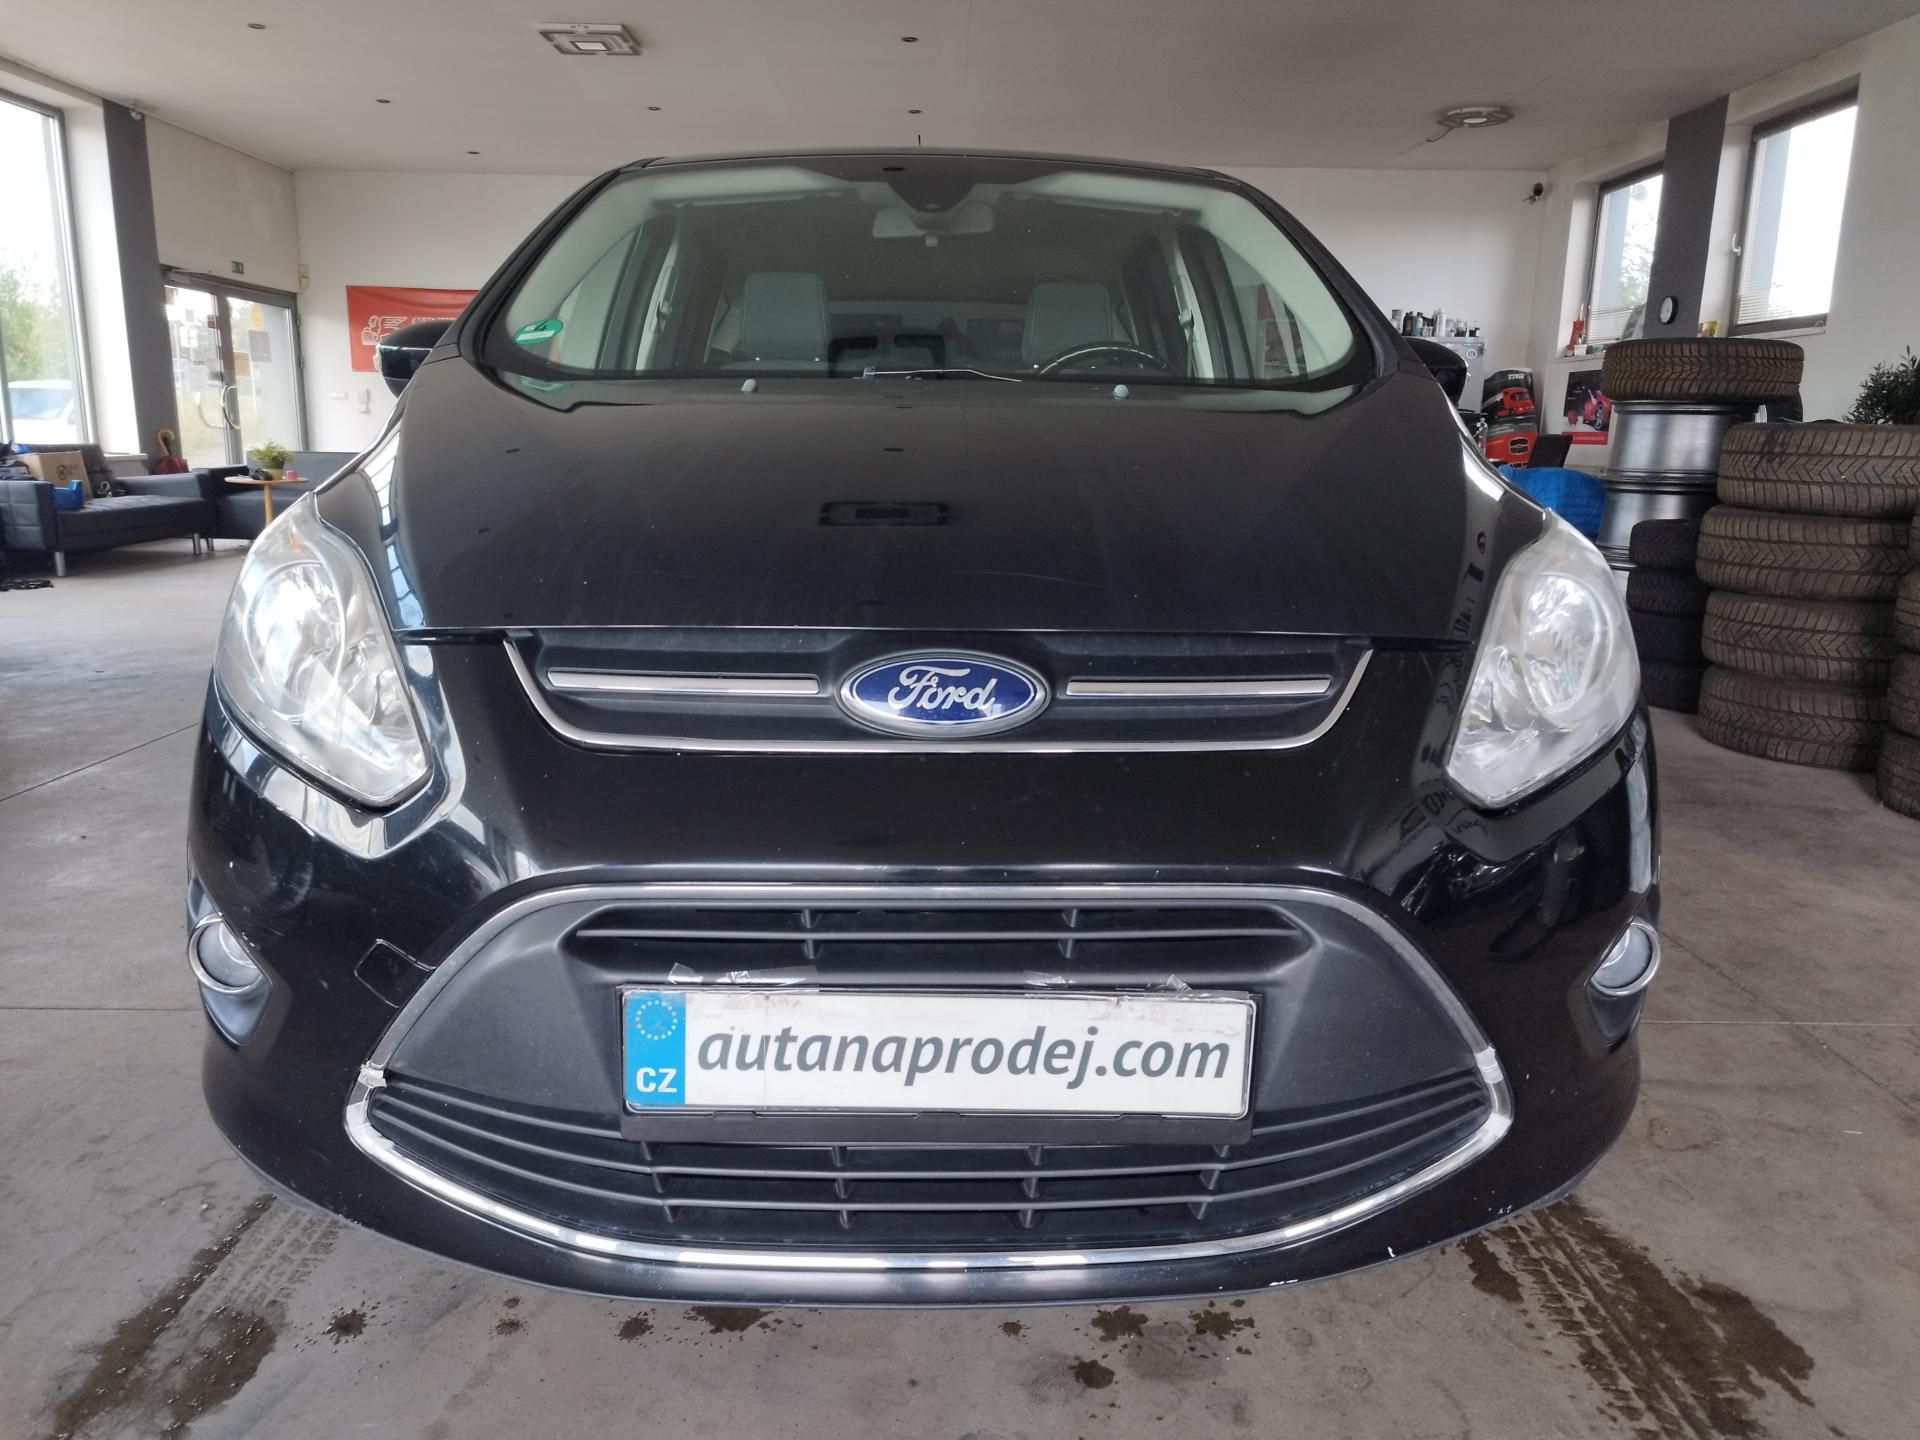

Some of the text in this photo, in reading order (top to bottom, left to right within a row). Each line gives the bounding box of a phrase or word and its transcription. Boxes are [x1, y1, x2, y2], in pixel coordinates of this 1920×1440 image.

[887, 665, 998, 710] Ford
[699, 1026, 1230, 1089] autanaprodej.com
[635, 1067, 678, 1094] CZ
